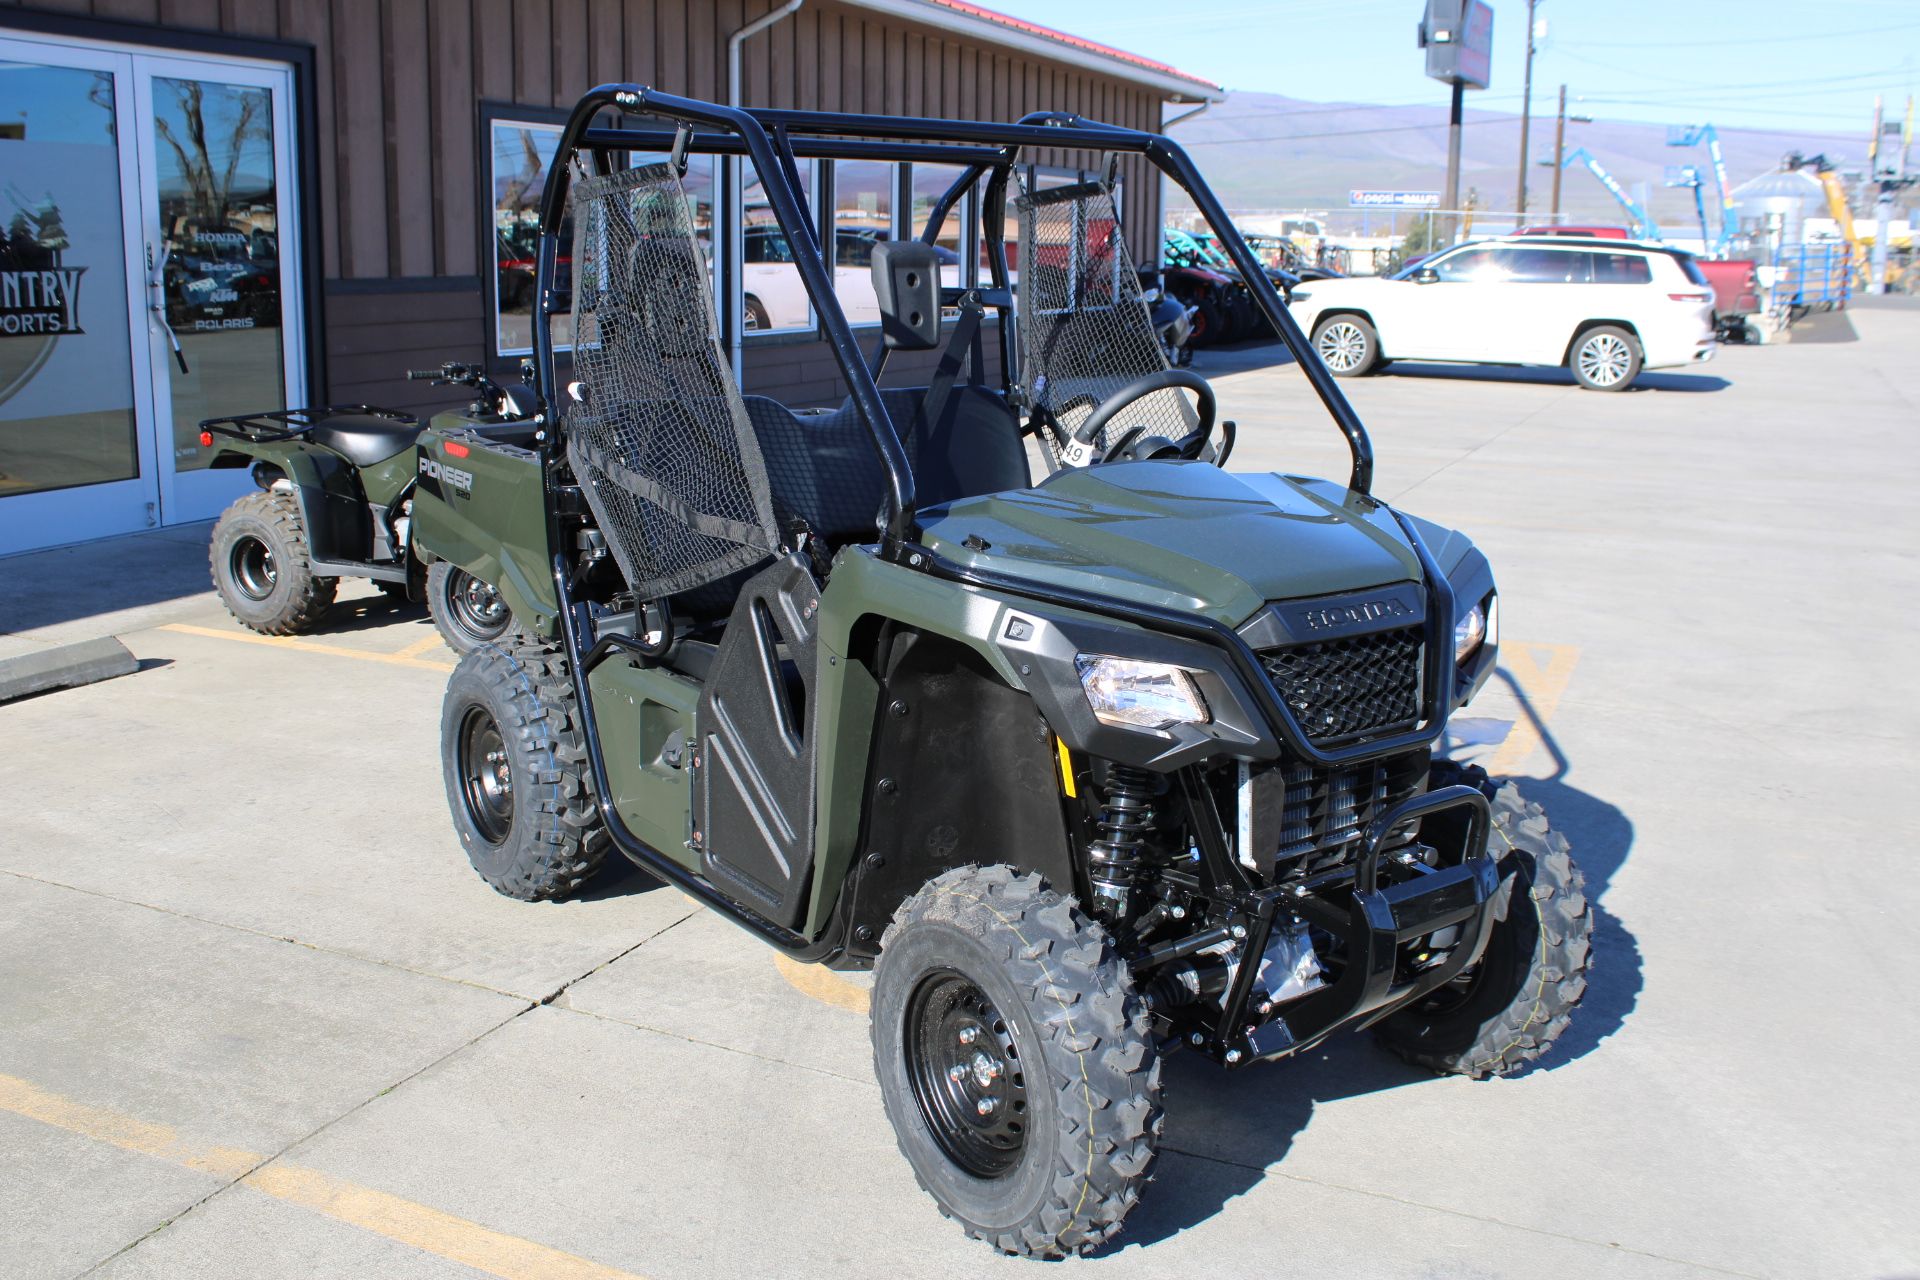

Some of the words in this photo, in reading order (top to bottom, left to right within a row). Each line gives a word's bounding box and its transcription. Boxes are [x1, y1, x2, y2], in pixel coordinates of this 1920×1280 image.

[195, 232, 247, 242] HONDA
[200, 262, 243, 271] Beta
[209, 289, 238, 302] KTM
[0, 313, 61, 333] ORTS
[195, 317, 254, 330] POLARIS
[419, 457, 472, 491] PIONEER
[456, 489, 470, 500] 520
[1301, 598, 1414, 629] HONDA
